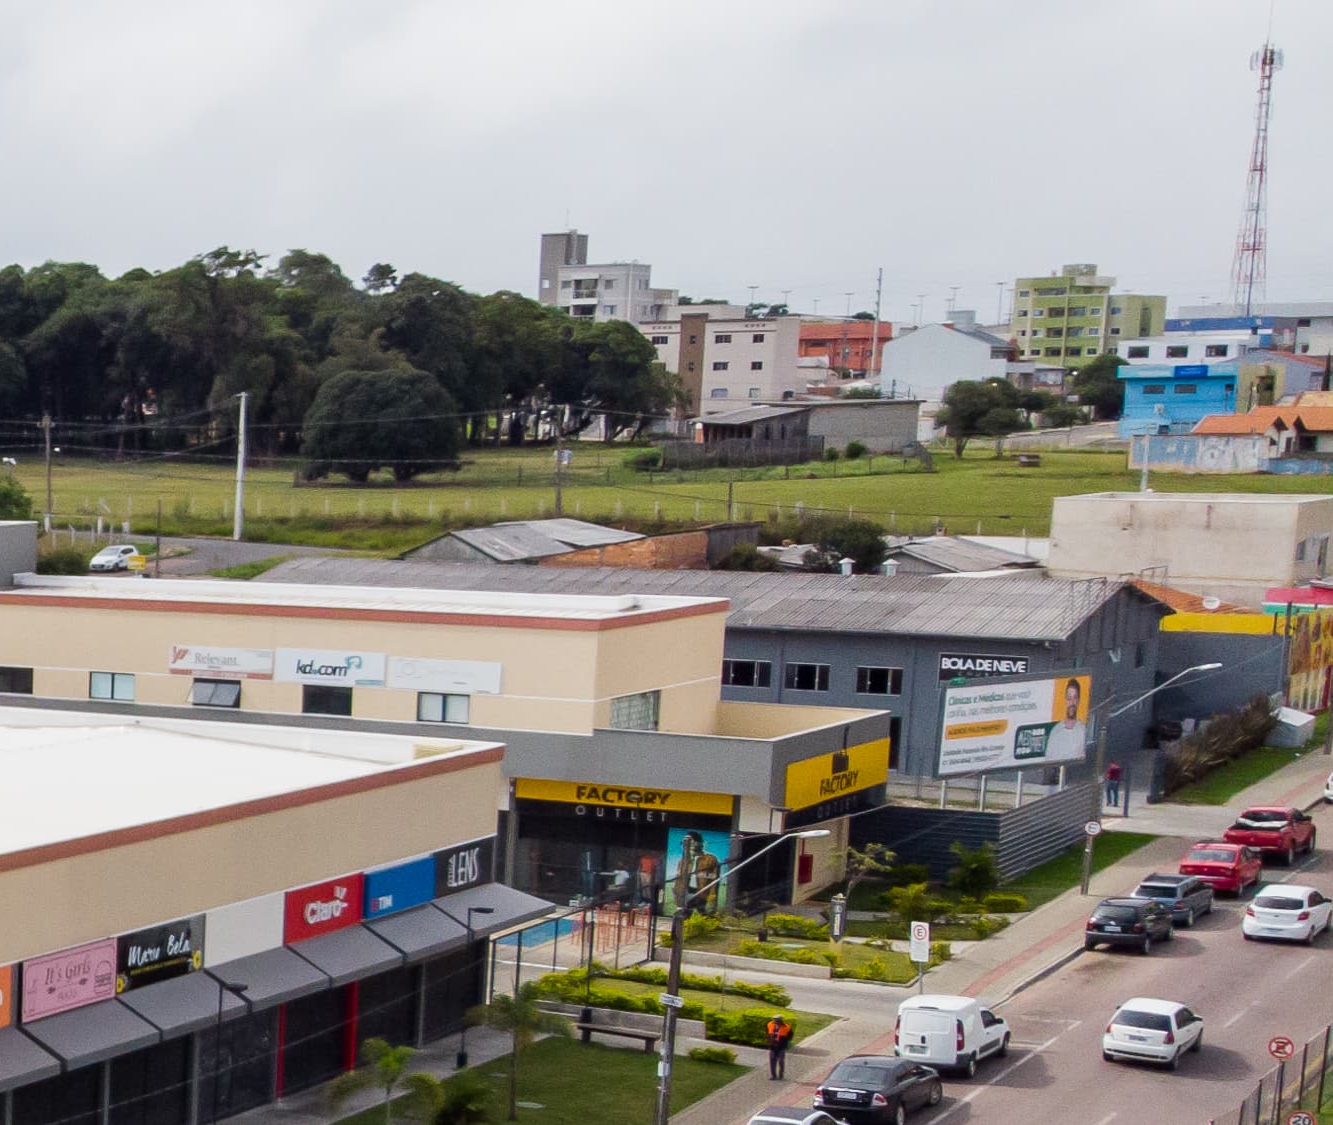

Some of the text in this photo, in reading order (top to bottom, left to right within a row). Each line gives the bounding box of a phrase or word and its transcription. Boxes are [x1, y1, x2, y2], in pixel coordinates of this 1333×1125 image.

[941, 657, 1027, 672] BOLA DE NEVE
[819, 770, 859, 796] FACTORY
[575, 786, 671, 805] FACTORY
[575, 805, 668, 822] OUTLET
[452, 847, 480, 888] LENS
[306, 898, 343, 925] Claro
